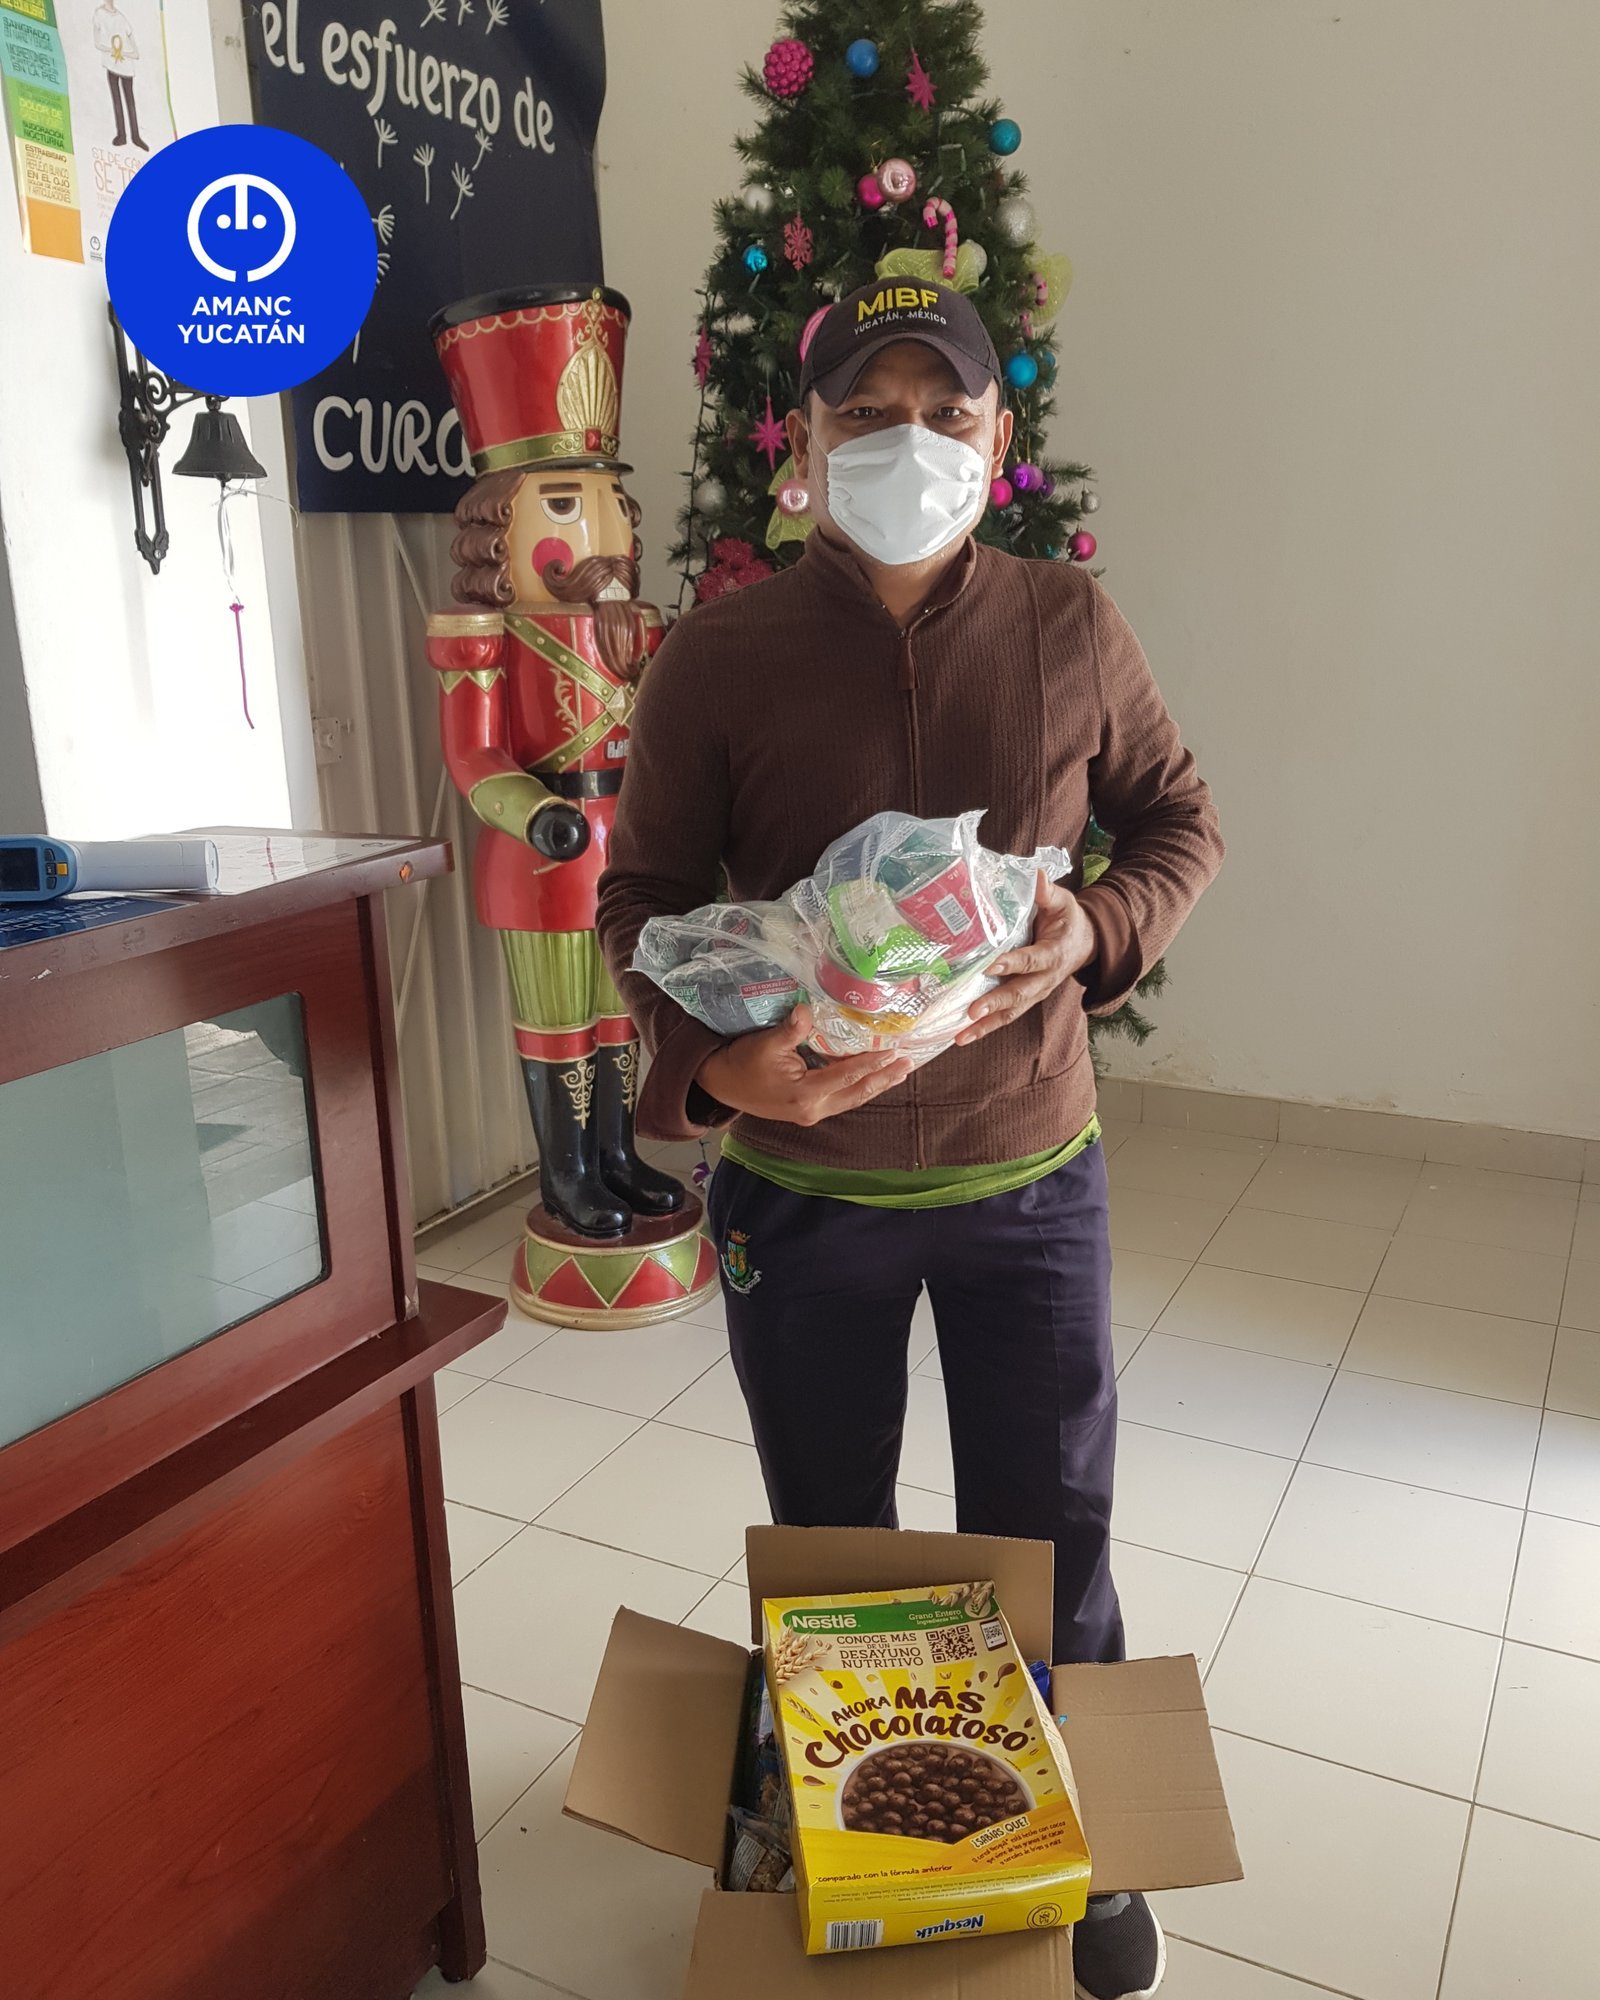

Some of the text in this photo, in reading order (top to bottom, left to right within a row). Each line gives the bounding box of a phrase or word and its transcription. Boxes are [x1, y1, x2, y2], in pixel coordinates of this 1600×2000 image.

[2, 16, 50, 41] SANGRADO
[262, 0, 556, 153] el esfuerzo de
[858, 287, 938, 322] MIBF
[907, 308, 947, 325] MÉXICO
[791, 1613, 858, 1629] Nestlé
[908, 1610, 962, 1621] Grano Entero
[836, 1632, 917, 1645] CONOCE MÁS
[840, 1647, 921, 1660] DESAYUNO
[842, 1657, 924, 1669] NUTRITIVO
[831, 1686, 986, 1726] AHORA MÁS
[971, 1816, 1029, 1848] ¿SABÍAS QUE?
[890, 1868, 919, 1877] fórmula
[922, 1865, 952, 1873] anterior
[916, 1914, 984, 1939] Nesquik
